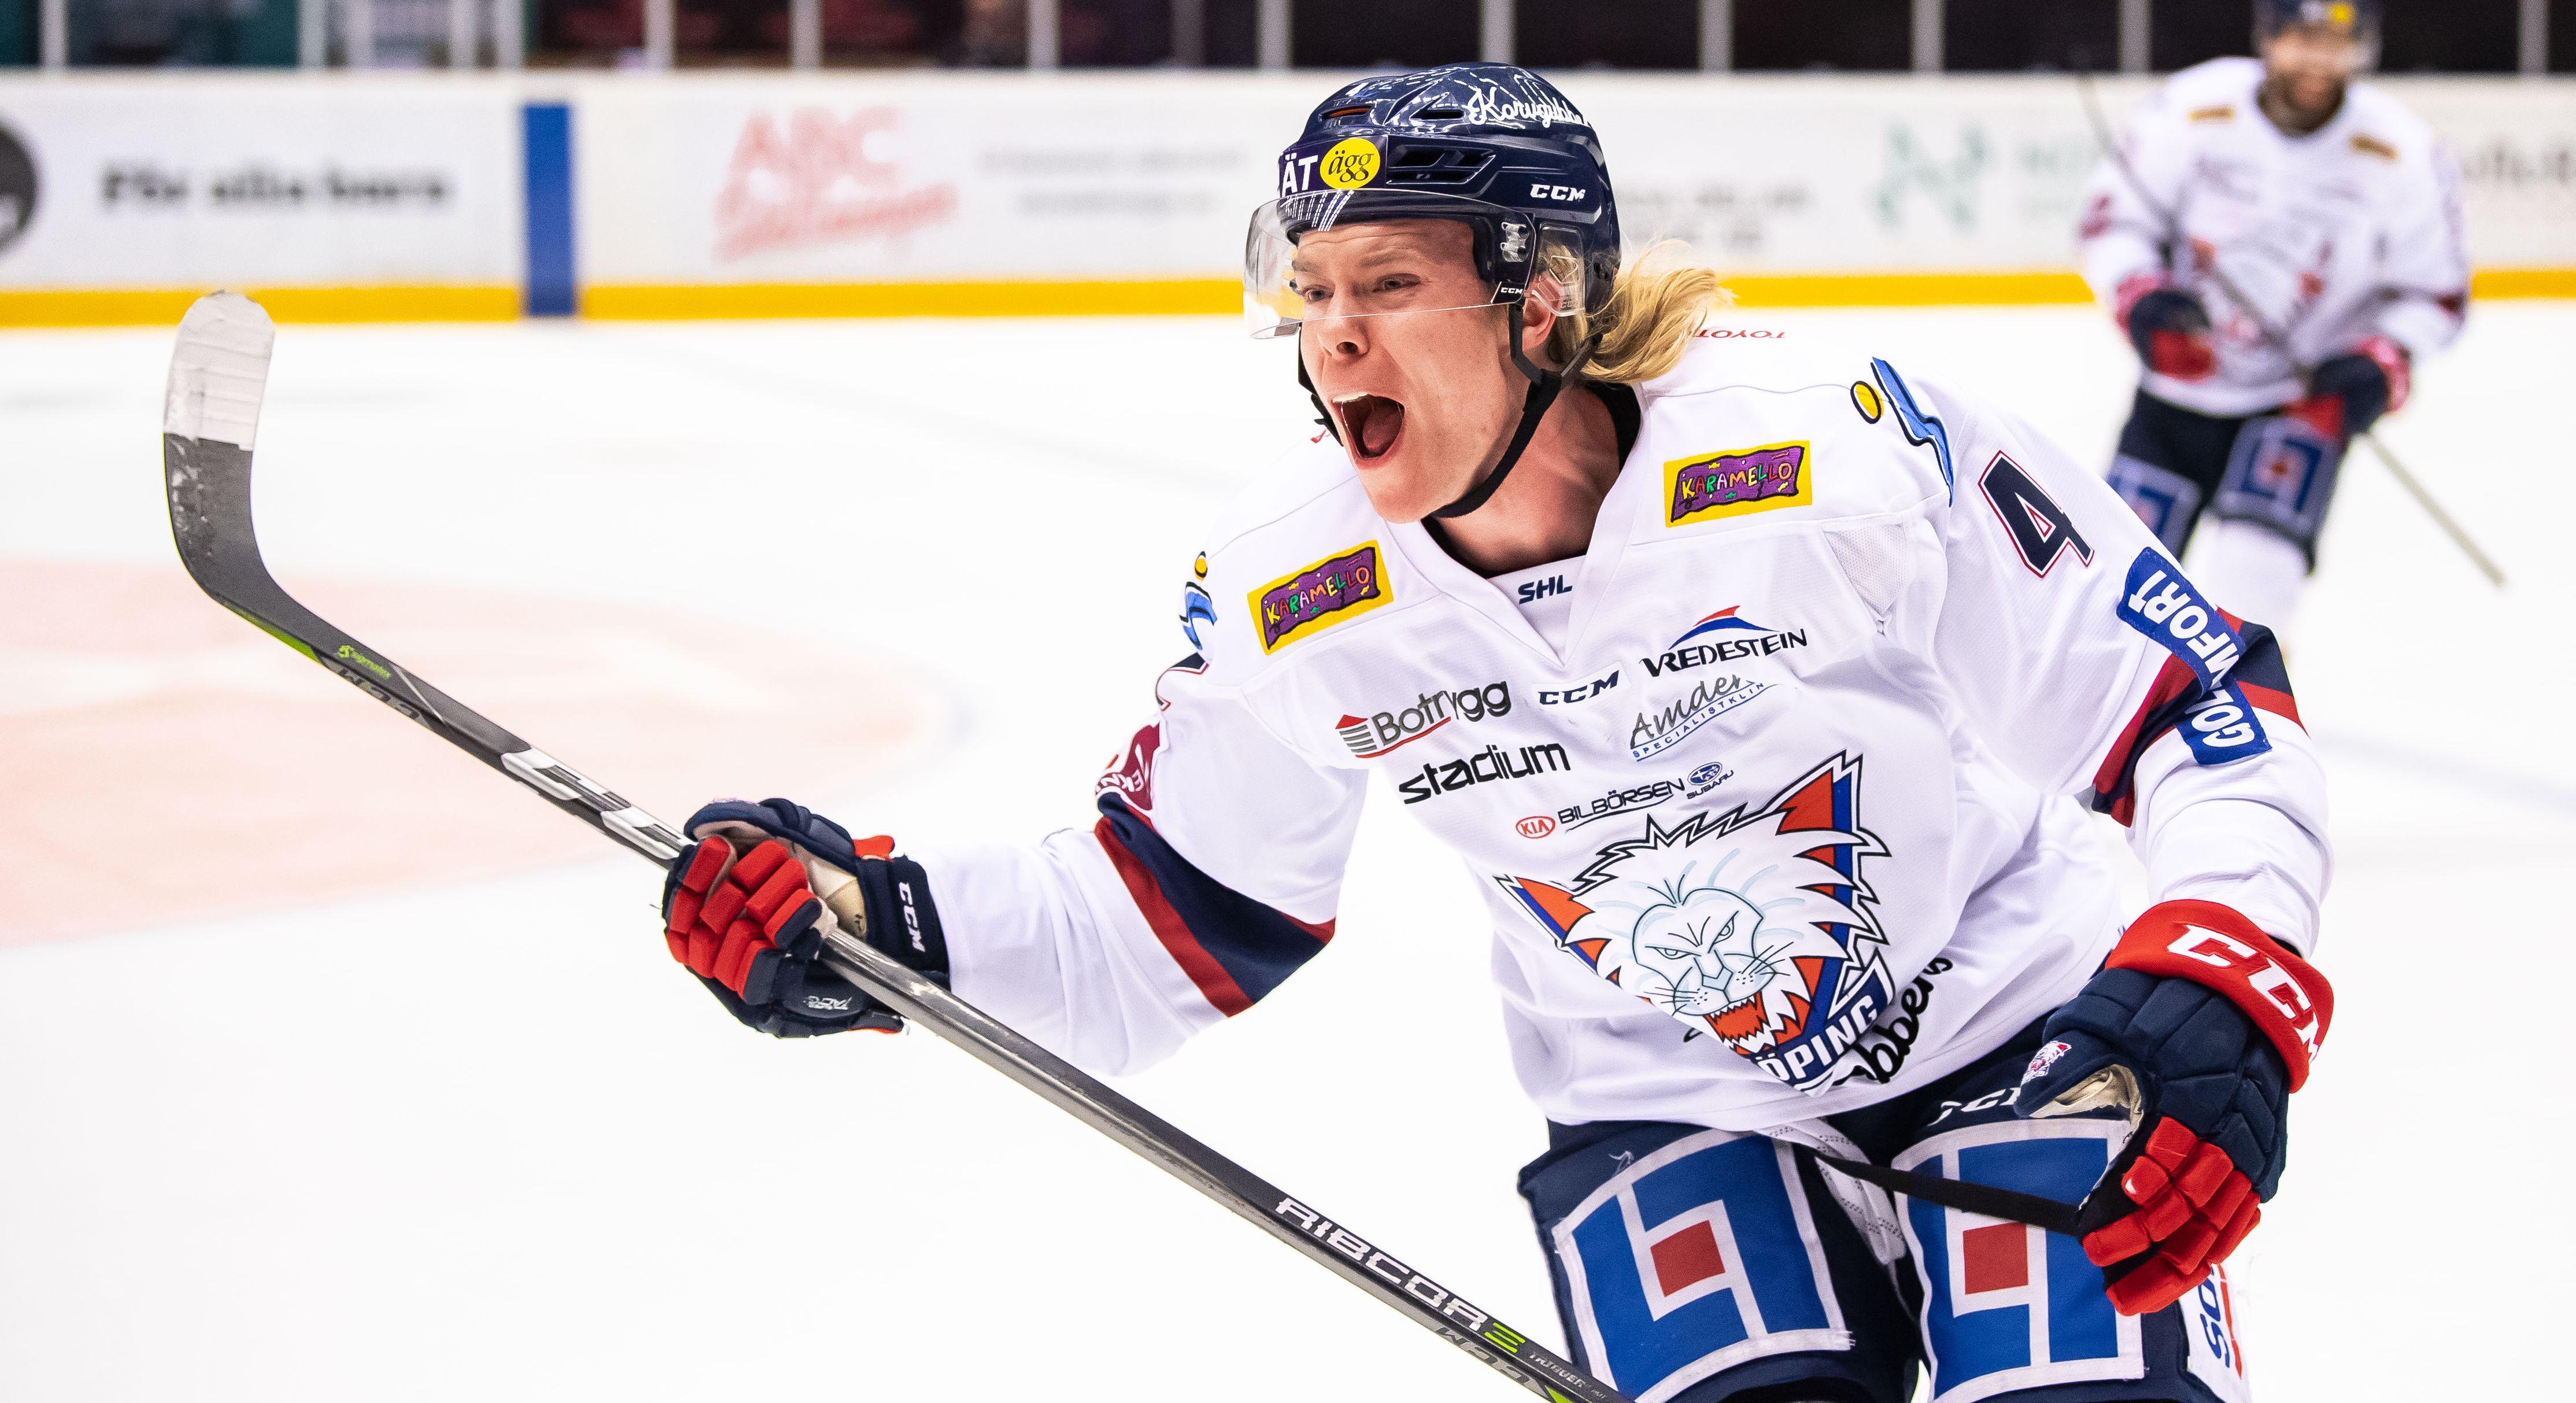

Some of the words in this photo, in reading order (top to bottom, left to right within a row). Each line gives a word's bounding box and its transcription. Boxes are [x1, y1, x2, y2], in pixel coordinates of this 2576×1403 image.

[1282, 152, 1318, 197] ÄT
[1328, 150, 1374, 183] ägg
[1530, 183, 1586, 201] CCM
[1689, 329, 1786, 338] TOYOT
[1681, 462, 1792, 500] KARAMELLO
[1978, 450, 2094, 578] 4
[1266, 567, 1370, 625] KARAMELLO
[1518, 574, 1573, 605] SHL
[1639, 628, 1808, 677] VREDESTEIN
[1538, 670, 1619, 705] CCM
[1371, 681, 1512, 747] Botrygg
[1399, 743, 1572, 804] stadium
[1520, 818, 1551, 837] KIA
[1557, 778, 1686, 825] BILBÖRSEN
[1686, 769, 1734, 799] SUBARU
[898, 881, 926, 952] CCM
